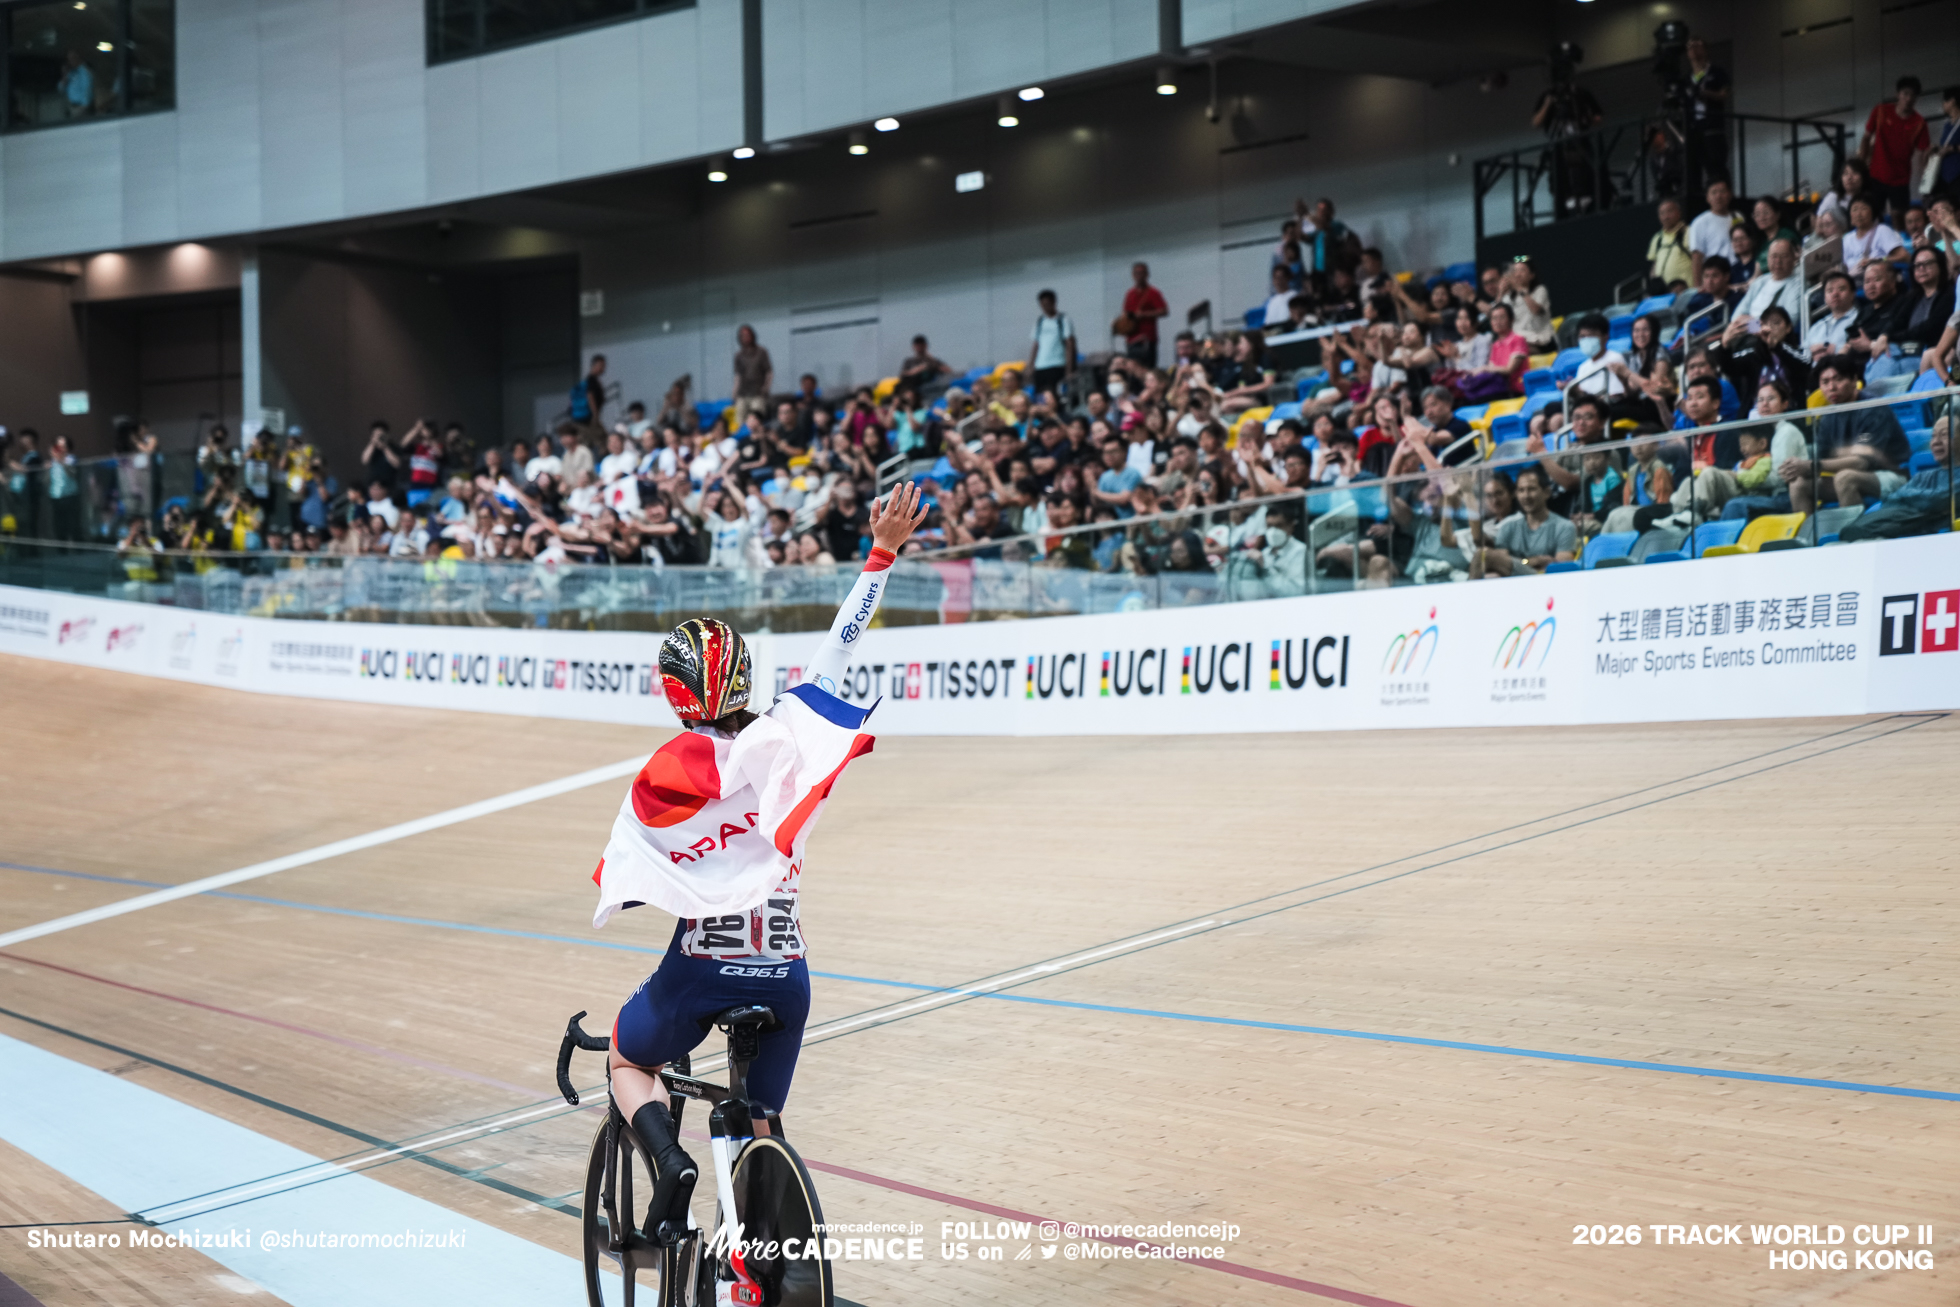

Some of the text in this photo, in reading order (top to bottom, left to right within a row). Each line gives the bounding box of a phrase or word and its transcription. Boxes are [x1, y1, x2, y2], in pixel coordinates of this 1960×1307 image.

[855, 582, 878, 622] Cyclers
[1596, 591, 1860, 643] 大型體育活動事務委員會
[367, 649, 398, 678] UCI
[413, 651, 443, 681] UCI
[459, 653, 490, 685] UCI
[505, 656, 537, 688] UCI
[571, 661, 635, 694] TISSOT
[1037, 653, 1086, 698] UCI
[1113, 649, 1167, 697] UCI
[1194, 642, 1252, 694] UCI
[1285, 635, 1351, 690] UCI
[1596, 639, 1856, 678] Major Sports Events Committee
[926, 658, 1016, 699] TISSOT
[697, 914, 745, 950] 94
[719, 965, 790, 979] Q36.5
